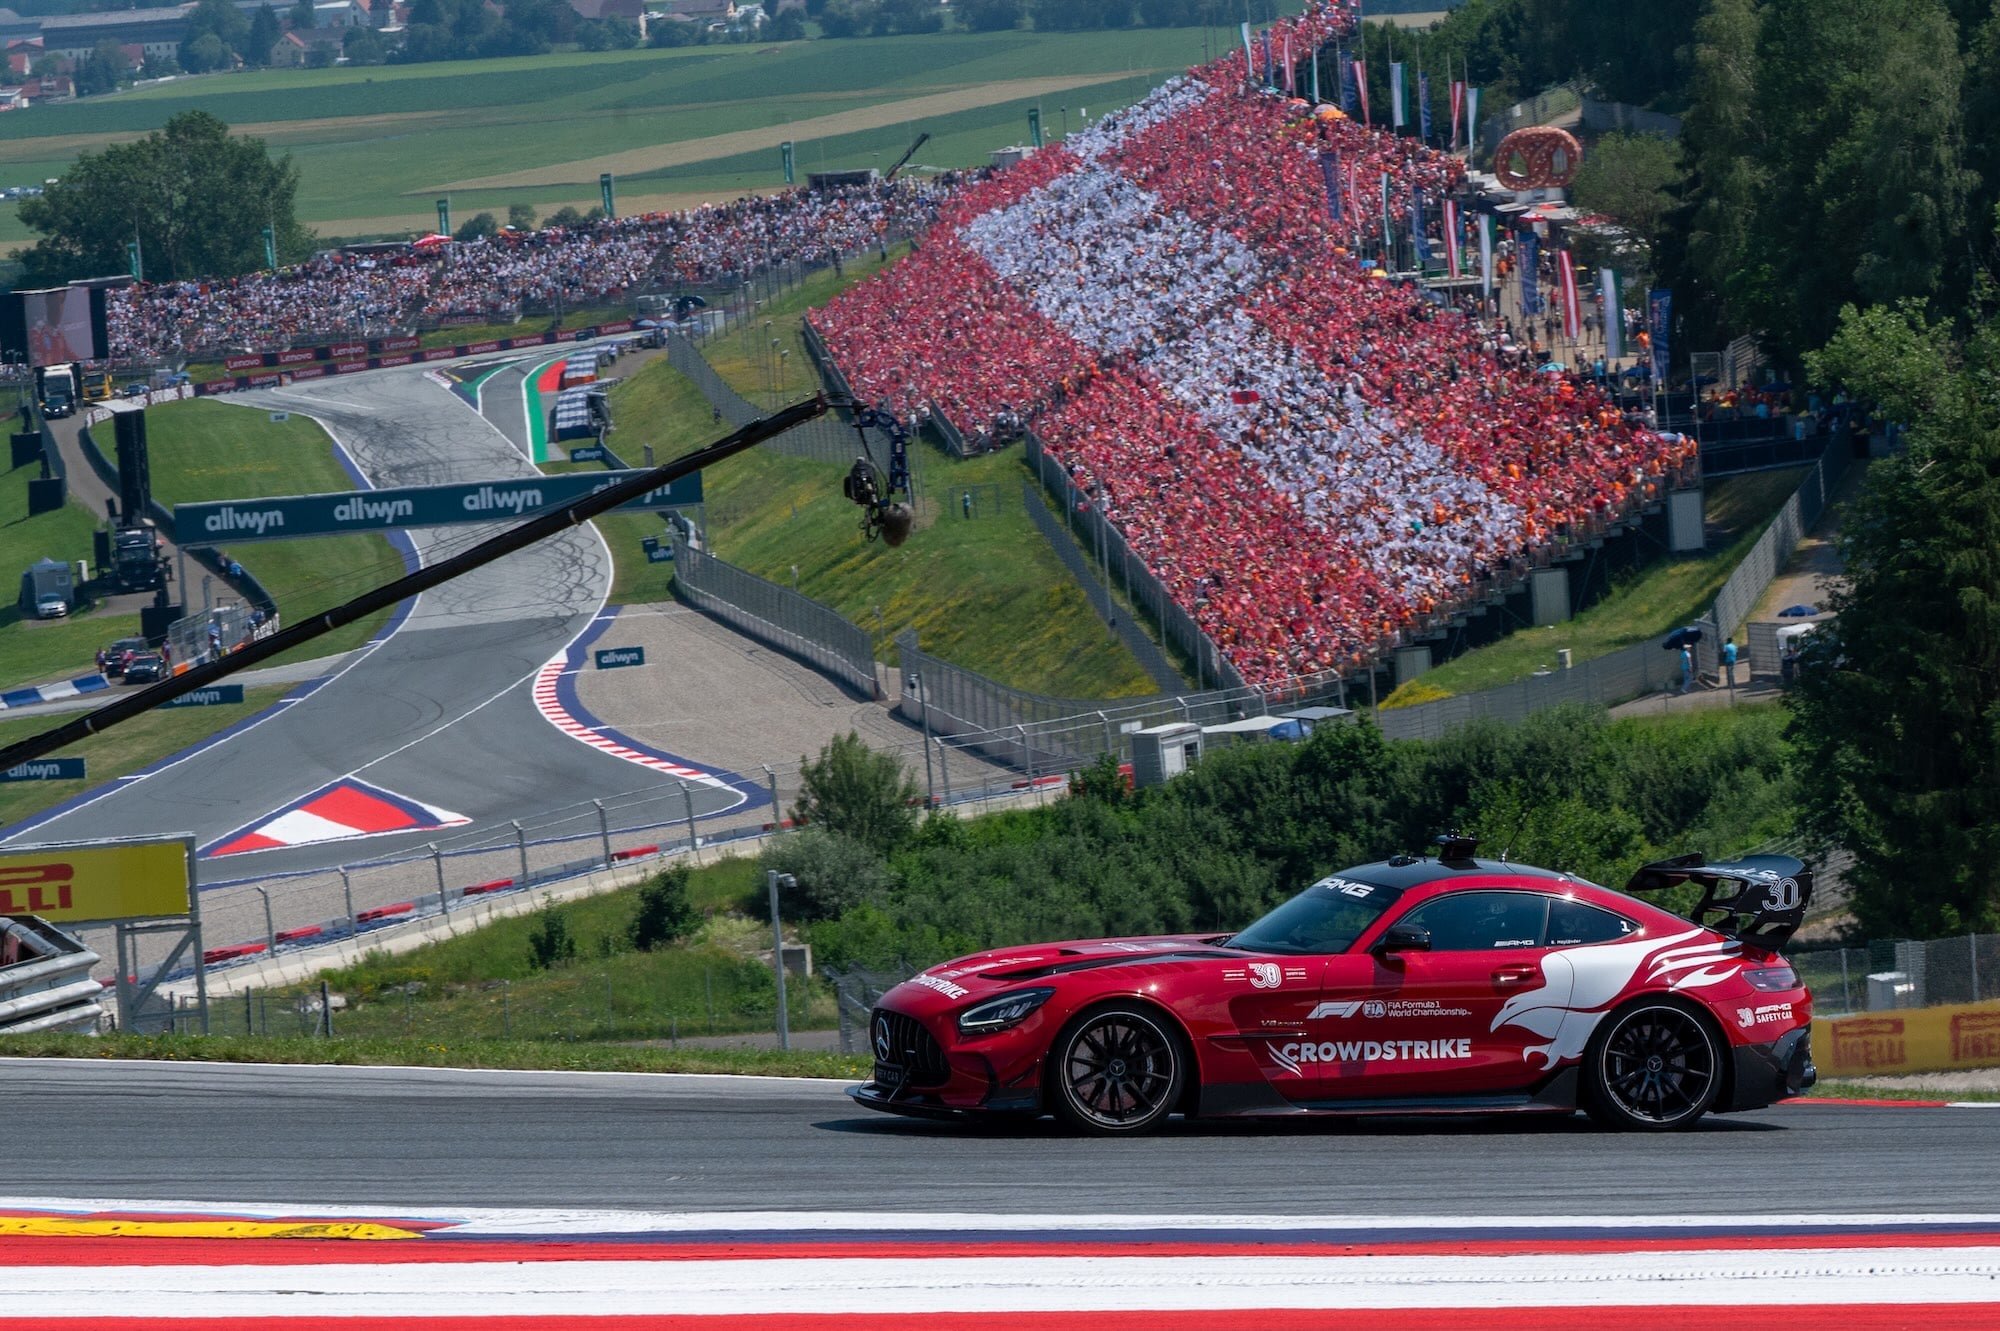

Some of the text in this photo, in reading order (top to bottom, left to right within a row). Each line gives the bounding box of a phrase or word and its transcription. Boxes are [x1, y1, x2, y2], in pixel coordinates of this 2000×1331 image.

[383, 339, 418, 351] Lenovo
[513, 336, 542, 347] Lenovo
[331, 345, 365, 357] Lenovo
[469, 343, 498, 354] Lenovo
[280, 352, 313, 363] Lenovo
[382, 356, 410, 366] Lenovo
[426, 349, 455, 361] Lenovo
[228, 358, 261, 369] Lenovo
[338, 361, 367, 372] Lenovo
[294, 368, 323, 379] Lenovo
[574, 449, 602, 460] allwyn
[463, 486, 543, 513] allwyn
[333, 497, 413, 524] allwyn
[205, 507, 284, 534] allwyn
[601, 651, 639, 664] allwyn
[1761, 878, 1799, 911] 30
[1620, 920, 1631, 933] 1
[1247, 963, 1282, 988] 30
[1401, 1001, 1435, 1009] Formula
[1768, 1003, 1792, 1012] AMG
[1387, 1009, 1412, 1017] World
[1736, 1007, 1755, 1028] 30
[1756, 1010, 1793, 1023] SAFETY CAR
[1282, 1038, 1472, 1063] CROWDSTRIKE
